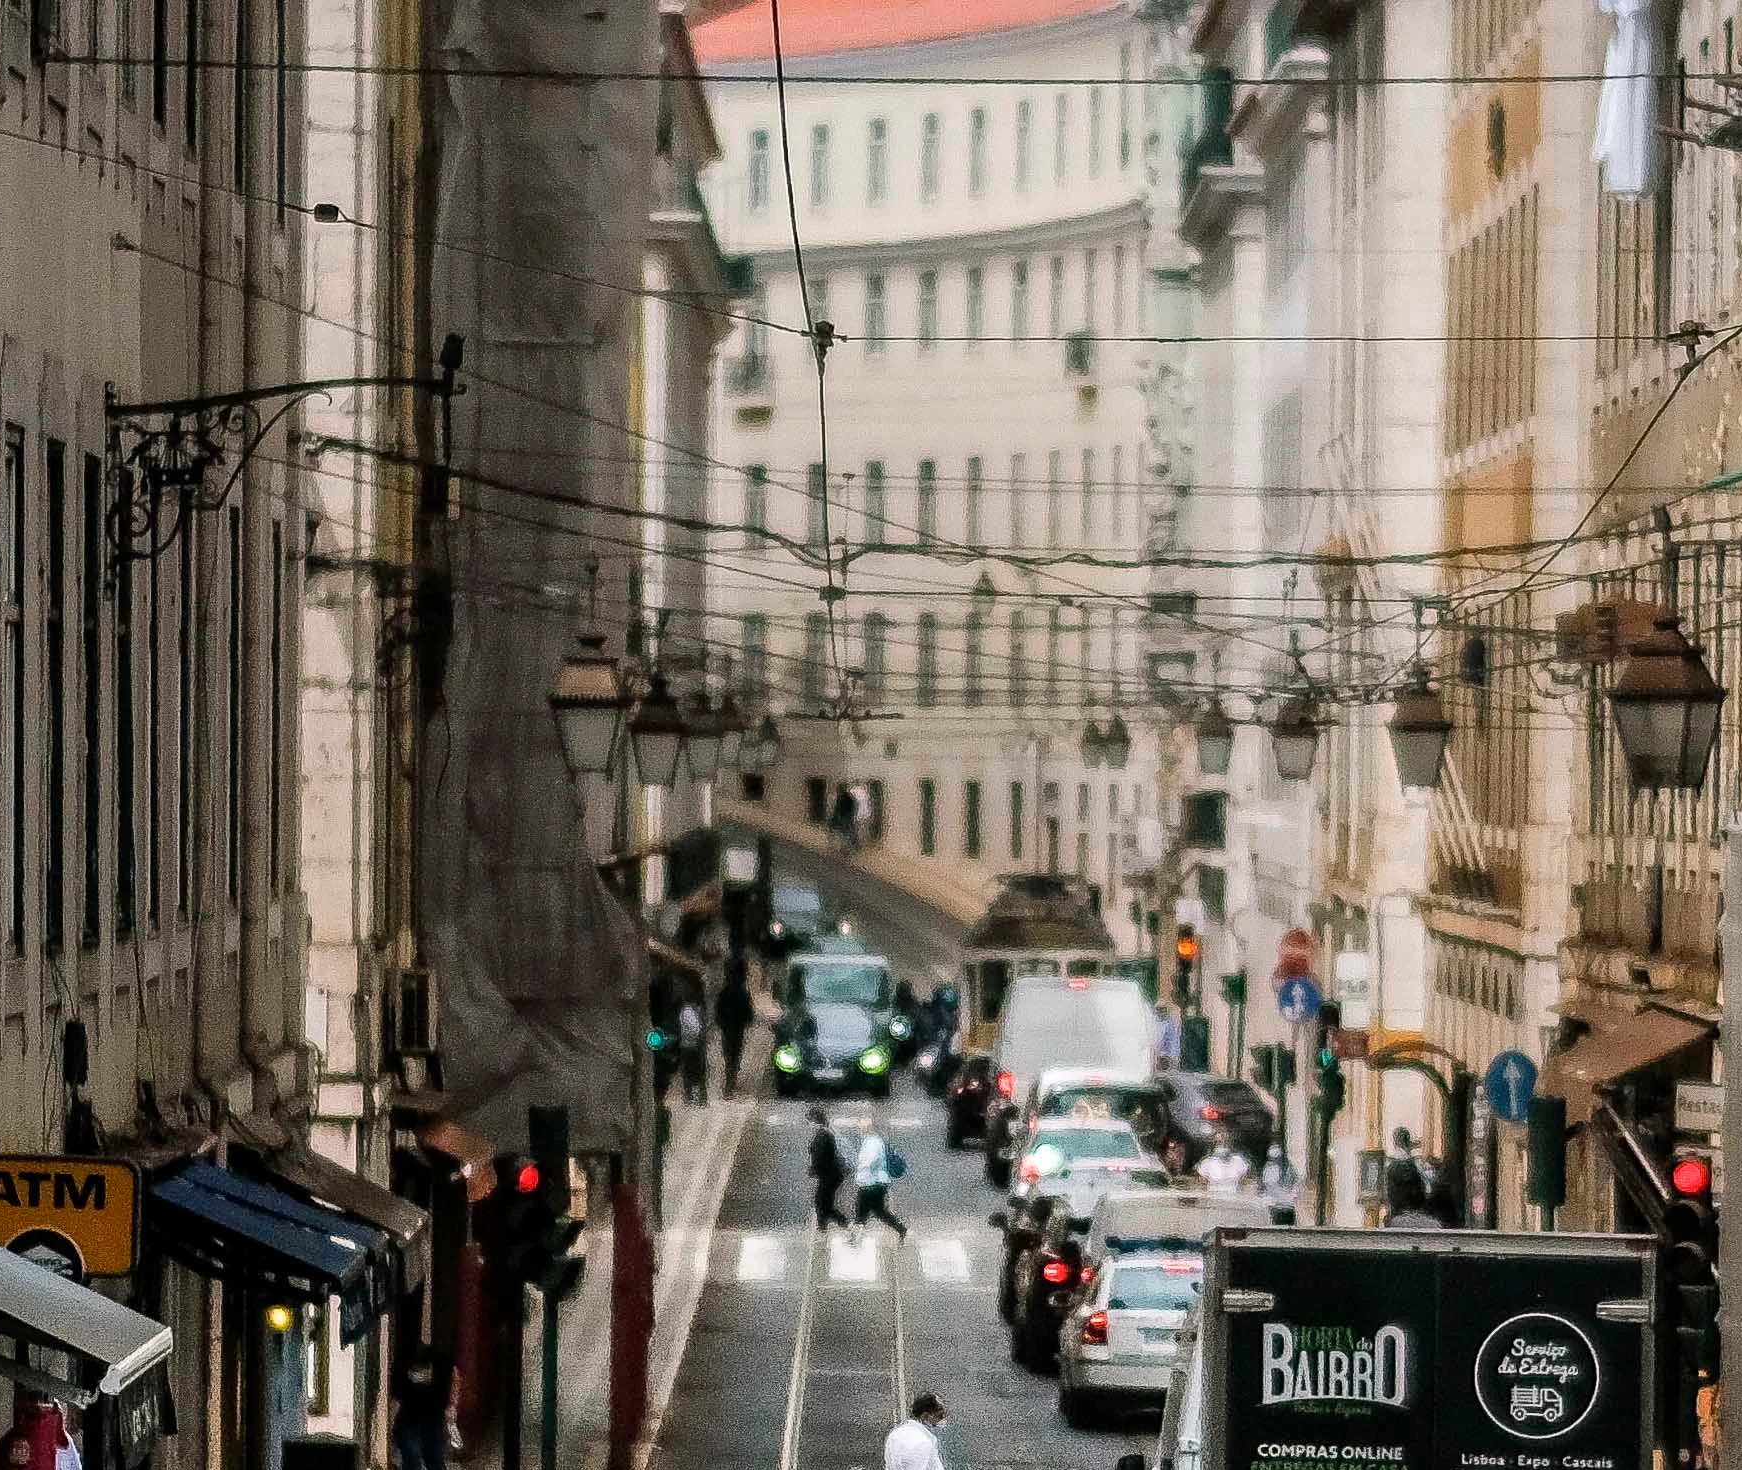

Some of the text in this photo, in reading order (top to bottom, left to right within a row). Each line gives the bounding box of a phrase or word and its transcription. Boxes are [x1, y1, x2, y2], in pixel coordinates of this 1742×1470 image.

[1357, 1337, 1373, 1350] do
[1262, 1323, 1405, 1404] BAIRRO
[1498, 1357, 1517, 1374] de
[1258, 1444, 1403, 1460] COMPRAS ONLINE
[1461, 1453, 1613, 1469] Lisboa Expo Cascais
